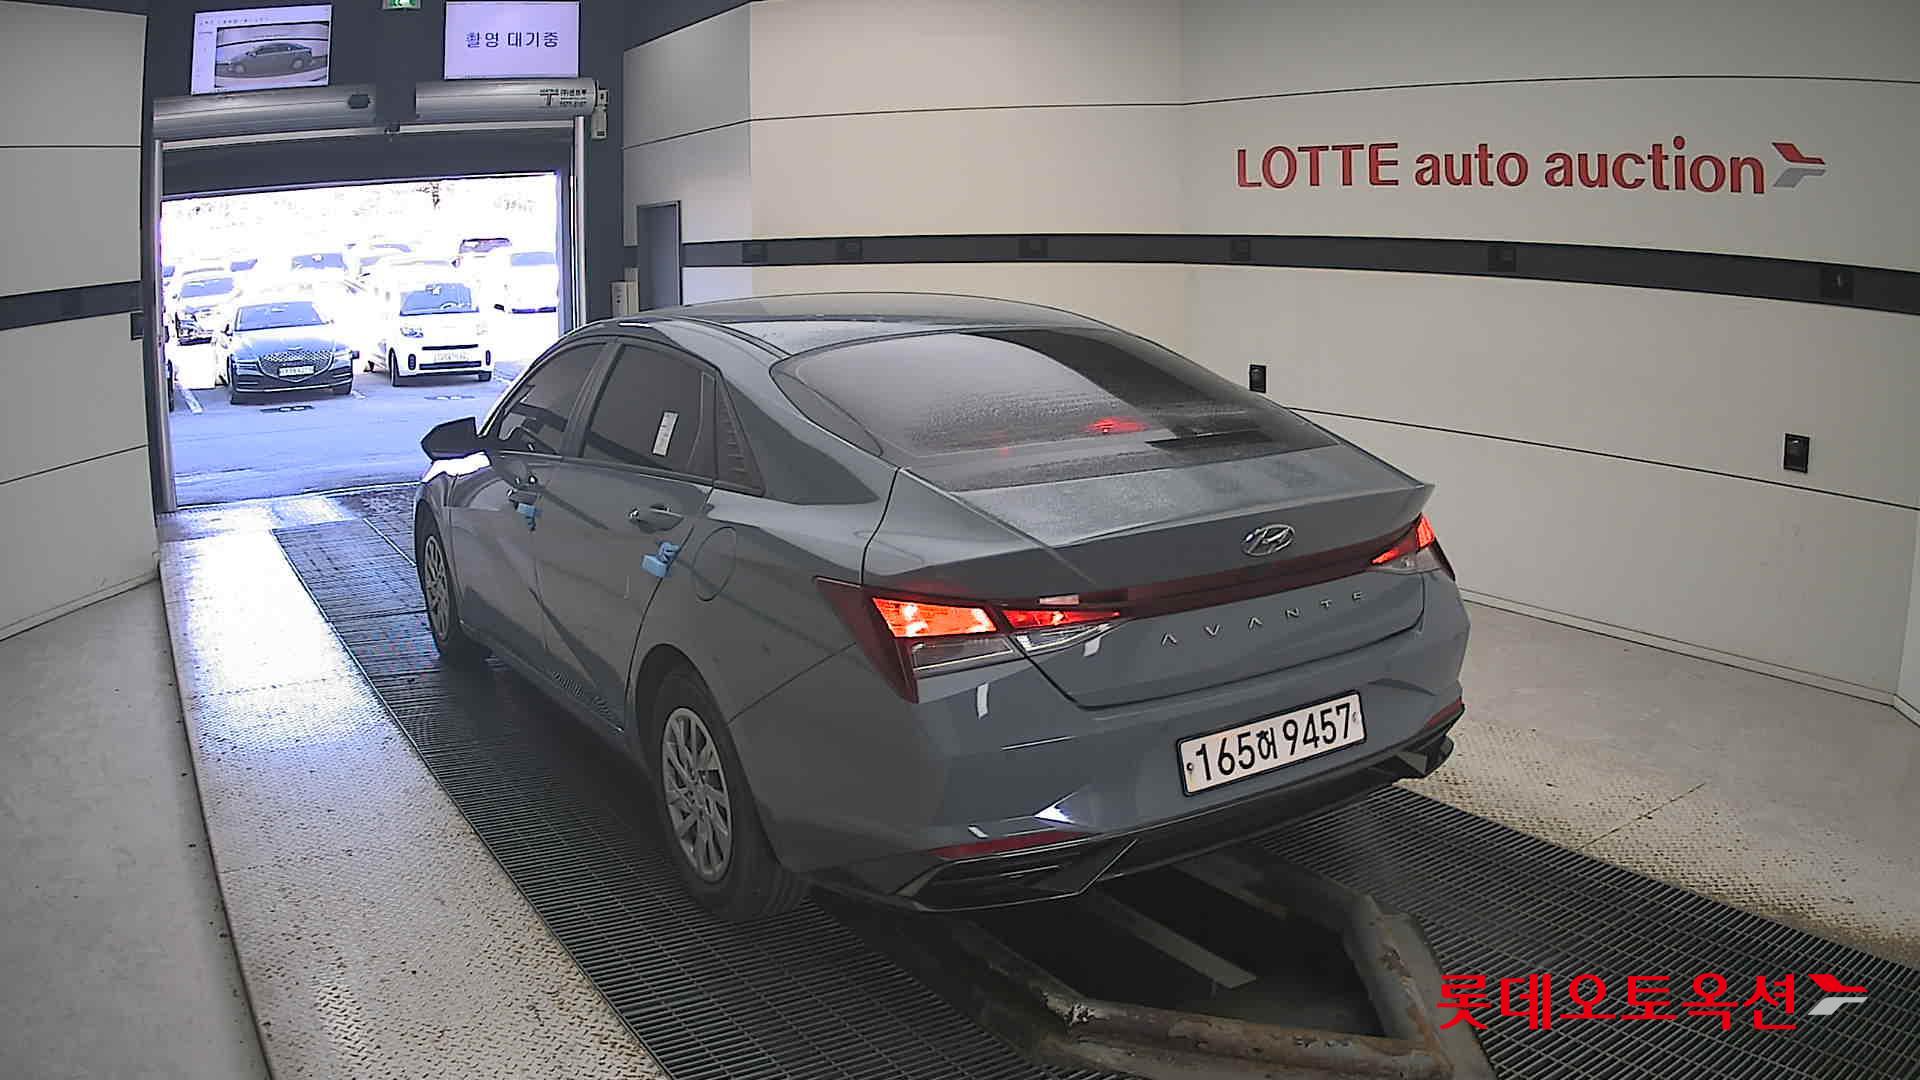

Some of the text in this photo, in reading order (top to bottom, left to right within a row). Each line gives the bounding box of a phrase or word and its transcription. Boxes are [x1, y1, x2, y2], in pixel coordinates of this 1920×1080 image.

[507, 31, 559, 48] 대기중
[1236, 136, 1765, 193] LOTTE auto auction
[1160, 591, 1363, 647] AVANTE
[1282, 702, 1351, 756] 9457
